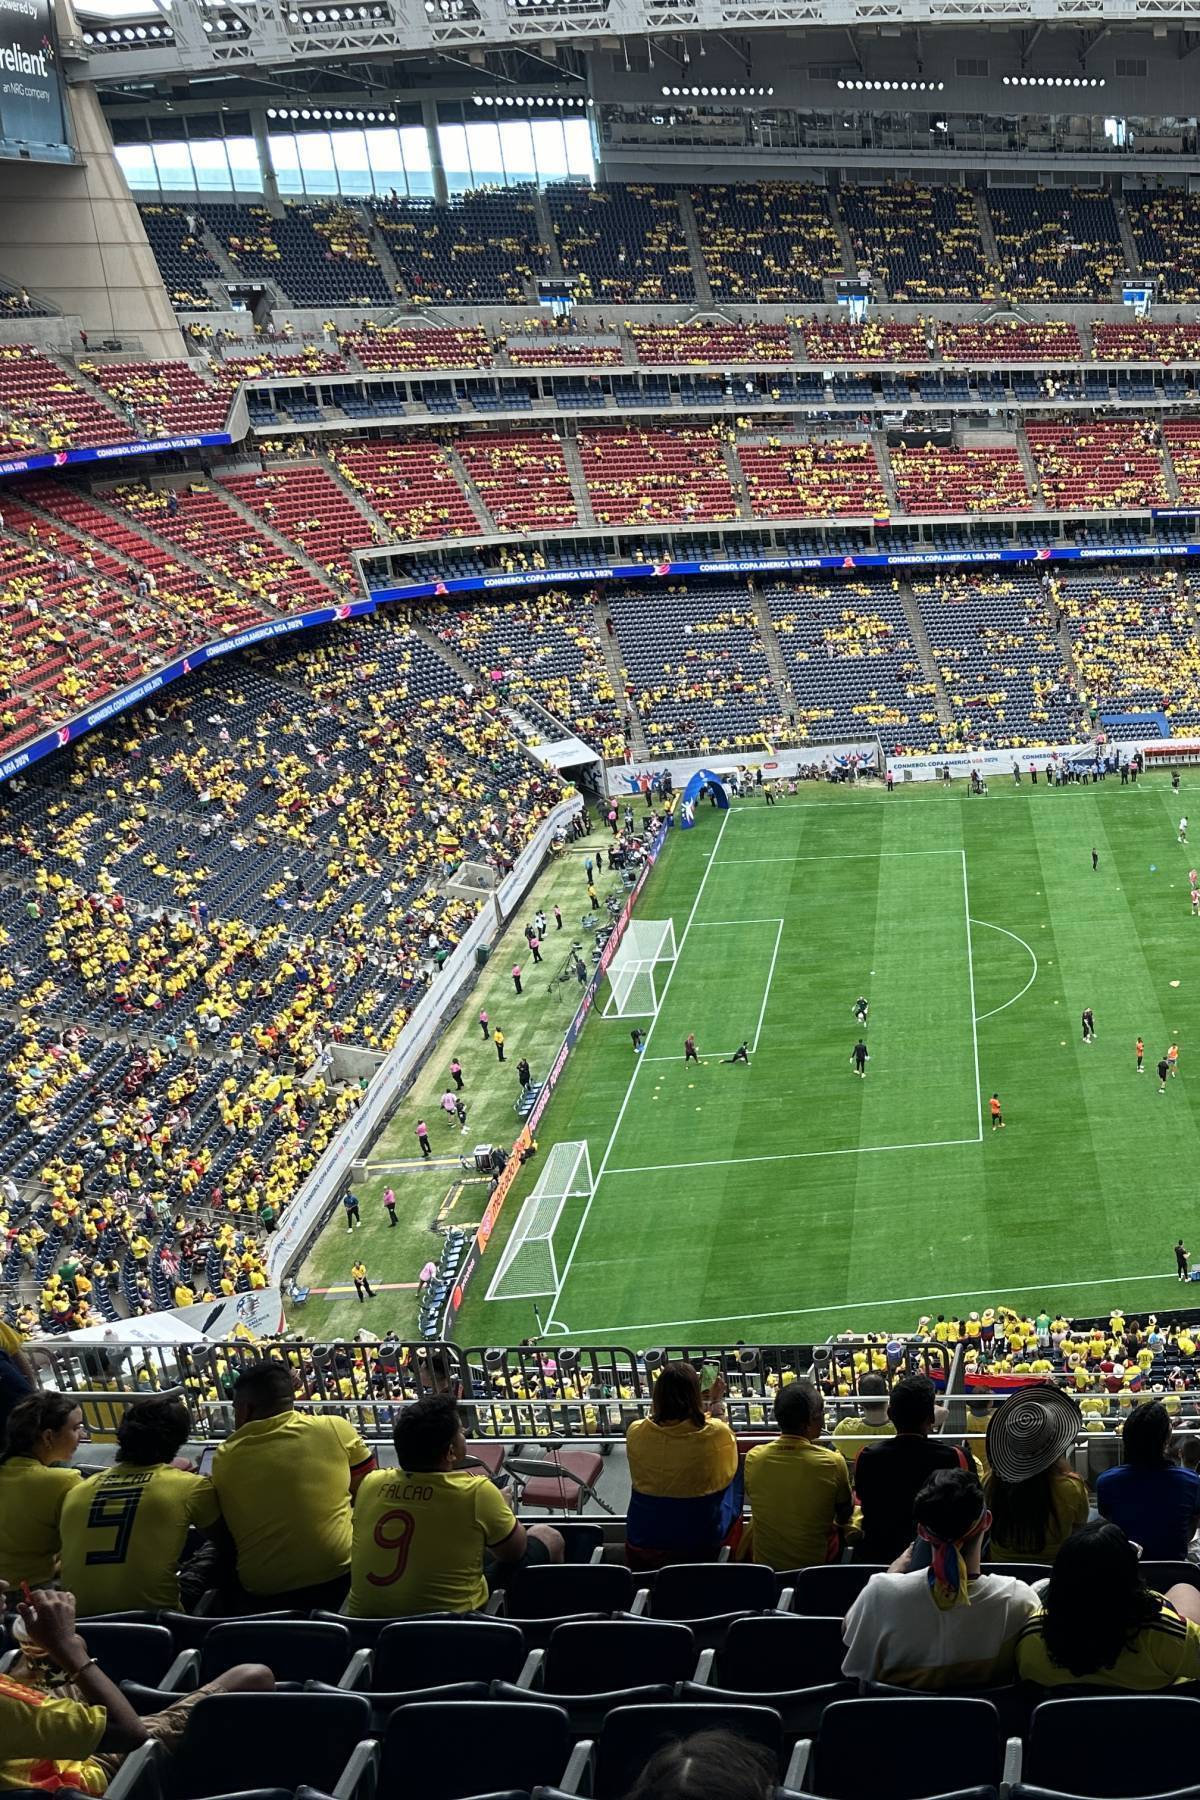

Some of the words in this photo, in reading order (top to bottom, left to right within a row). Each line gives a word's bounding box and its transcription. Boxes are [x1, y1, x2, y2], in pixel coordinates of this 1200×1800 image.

[28, 3, 38, 20] by
[0, 43, 48, 77] reliant
[24, 87, 50, 102] company
[377, 1483, 434, 1501] FALCAO
[86, 1486, 144, 1566] 9
[366, 1508, 416, 1587] 9
